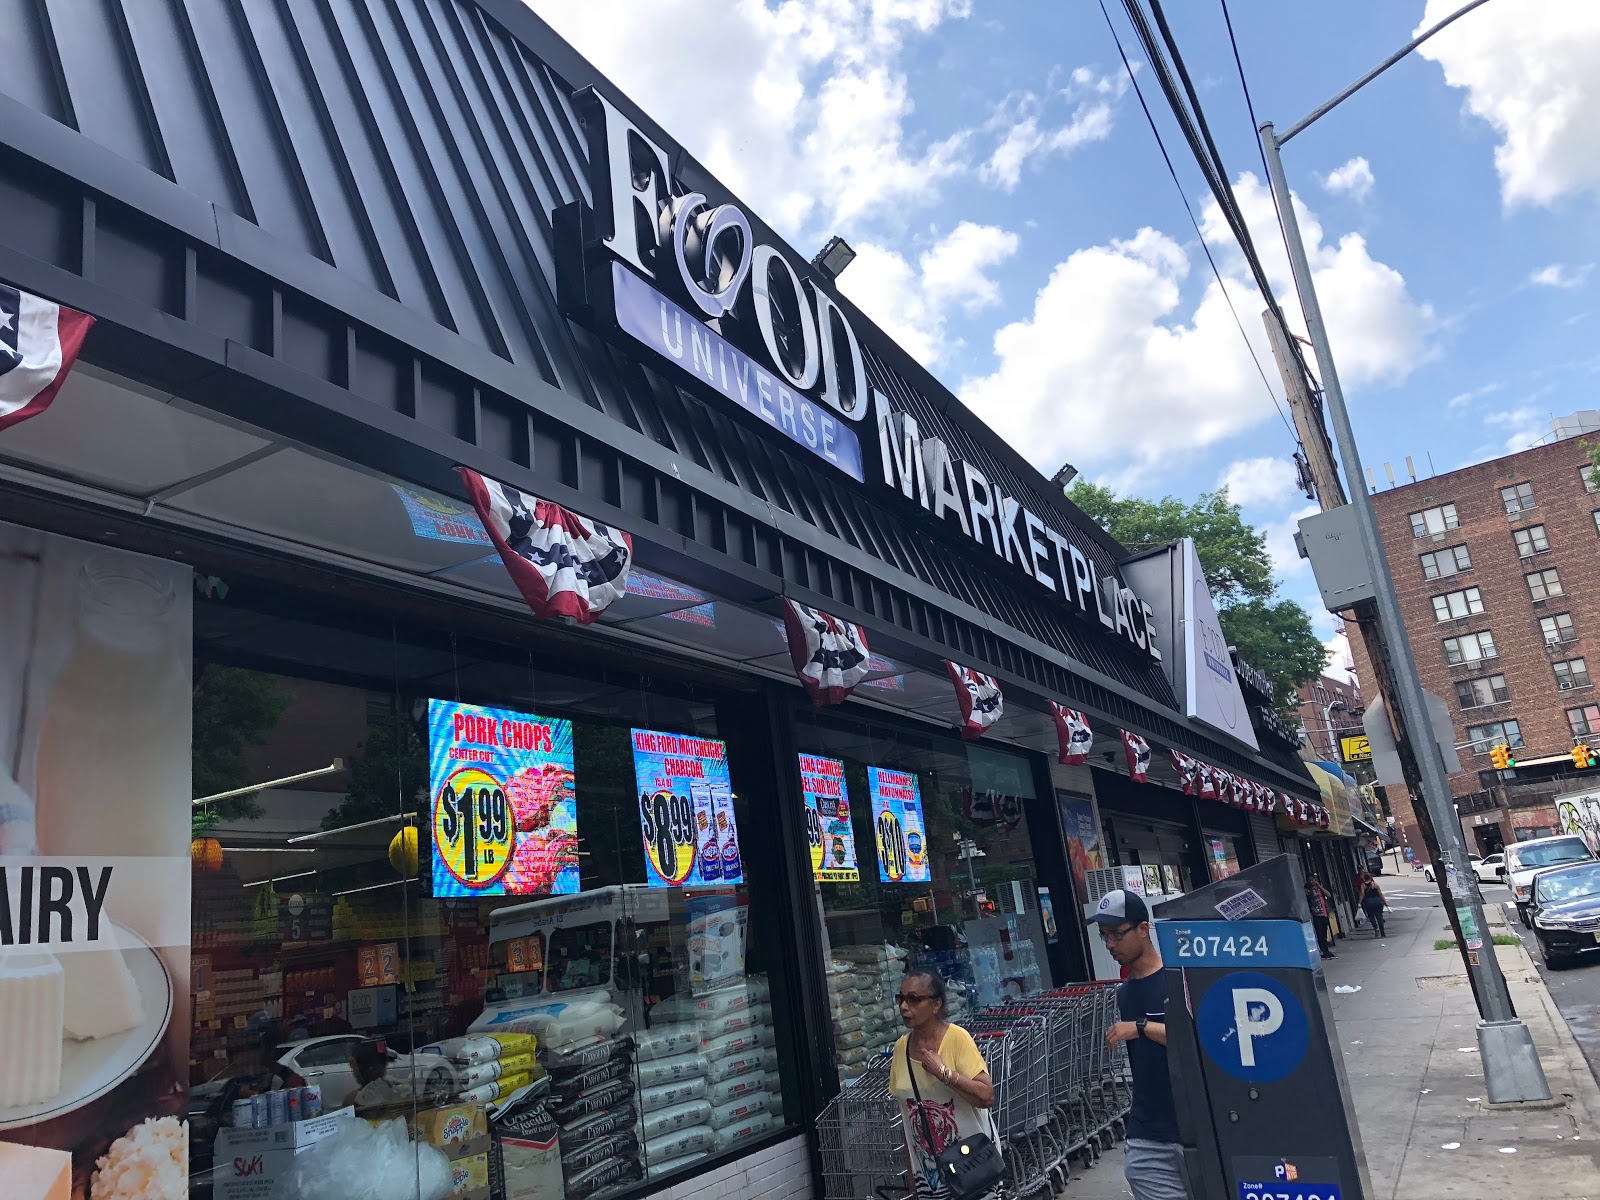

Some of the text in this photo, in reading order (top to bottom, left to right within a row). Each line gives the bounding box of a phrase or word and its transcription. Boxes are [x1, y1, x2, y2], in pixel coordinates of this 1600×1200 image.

[589, 84, 868, 422] FOOD
[660, 300, 839, 462] UNIVERSE
[872, 387, 1163, 662] MARKETPLACE
[453, 712, 553, 752] PORK CHOPS
[449, 747, 494, 763] CENTER CUT
[635, 732, 724, 760] KING FORD MATCHLIGHT
[664, 757, 705, 779] CHARCOAL
[484, 848, 495, 865] LB
[292, 919, 301, 939] 5
[1177, 935, 1269, 958] 207424
[363, 957, 375, 977] 2
[382, 954, 394, 975] 2
[1231, 987, 1284, 1067] P
[443, 1117, 469, 1140] Snapple
